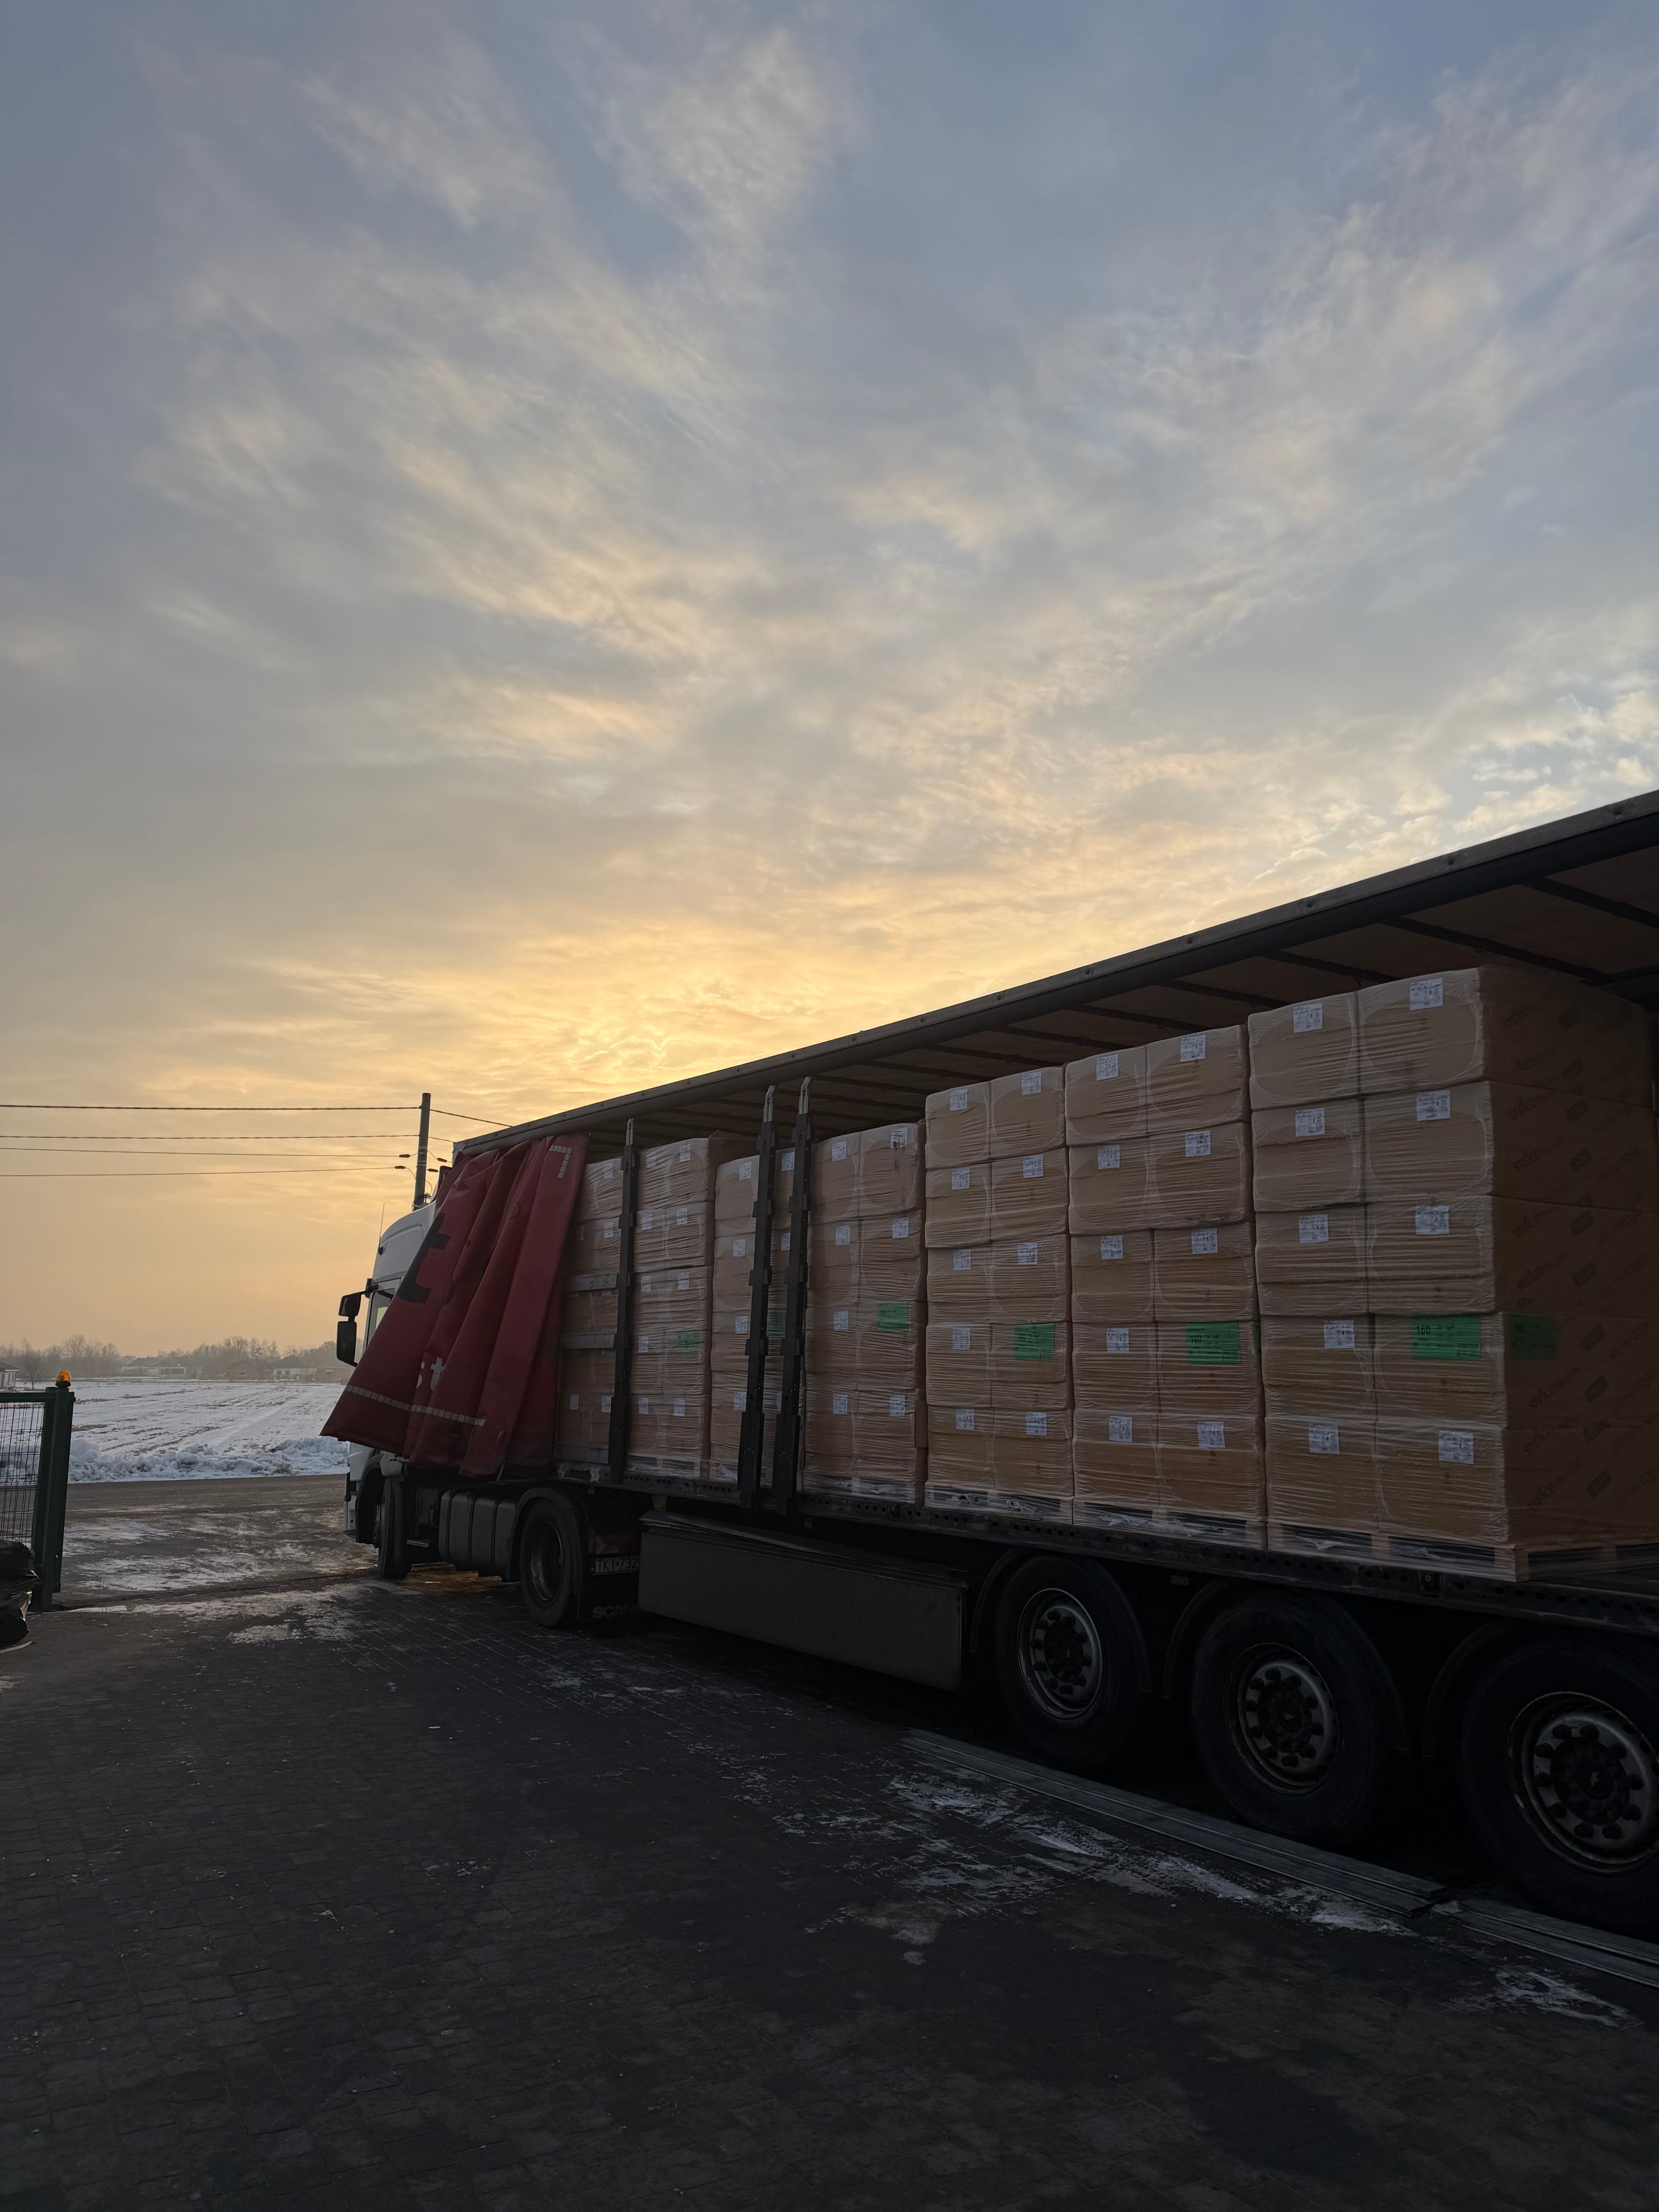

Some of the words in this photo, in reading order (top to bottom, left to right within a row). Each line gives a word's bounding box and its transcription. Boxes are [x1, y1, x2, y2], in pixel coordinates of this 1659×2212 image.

[1416, 1325, 1431, 1334] 160
[1191, 1335, 1202, 1343] 160
[597, 1558, 614, 1571] TKI
